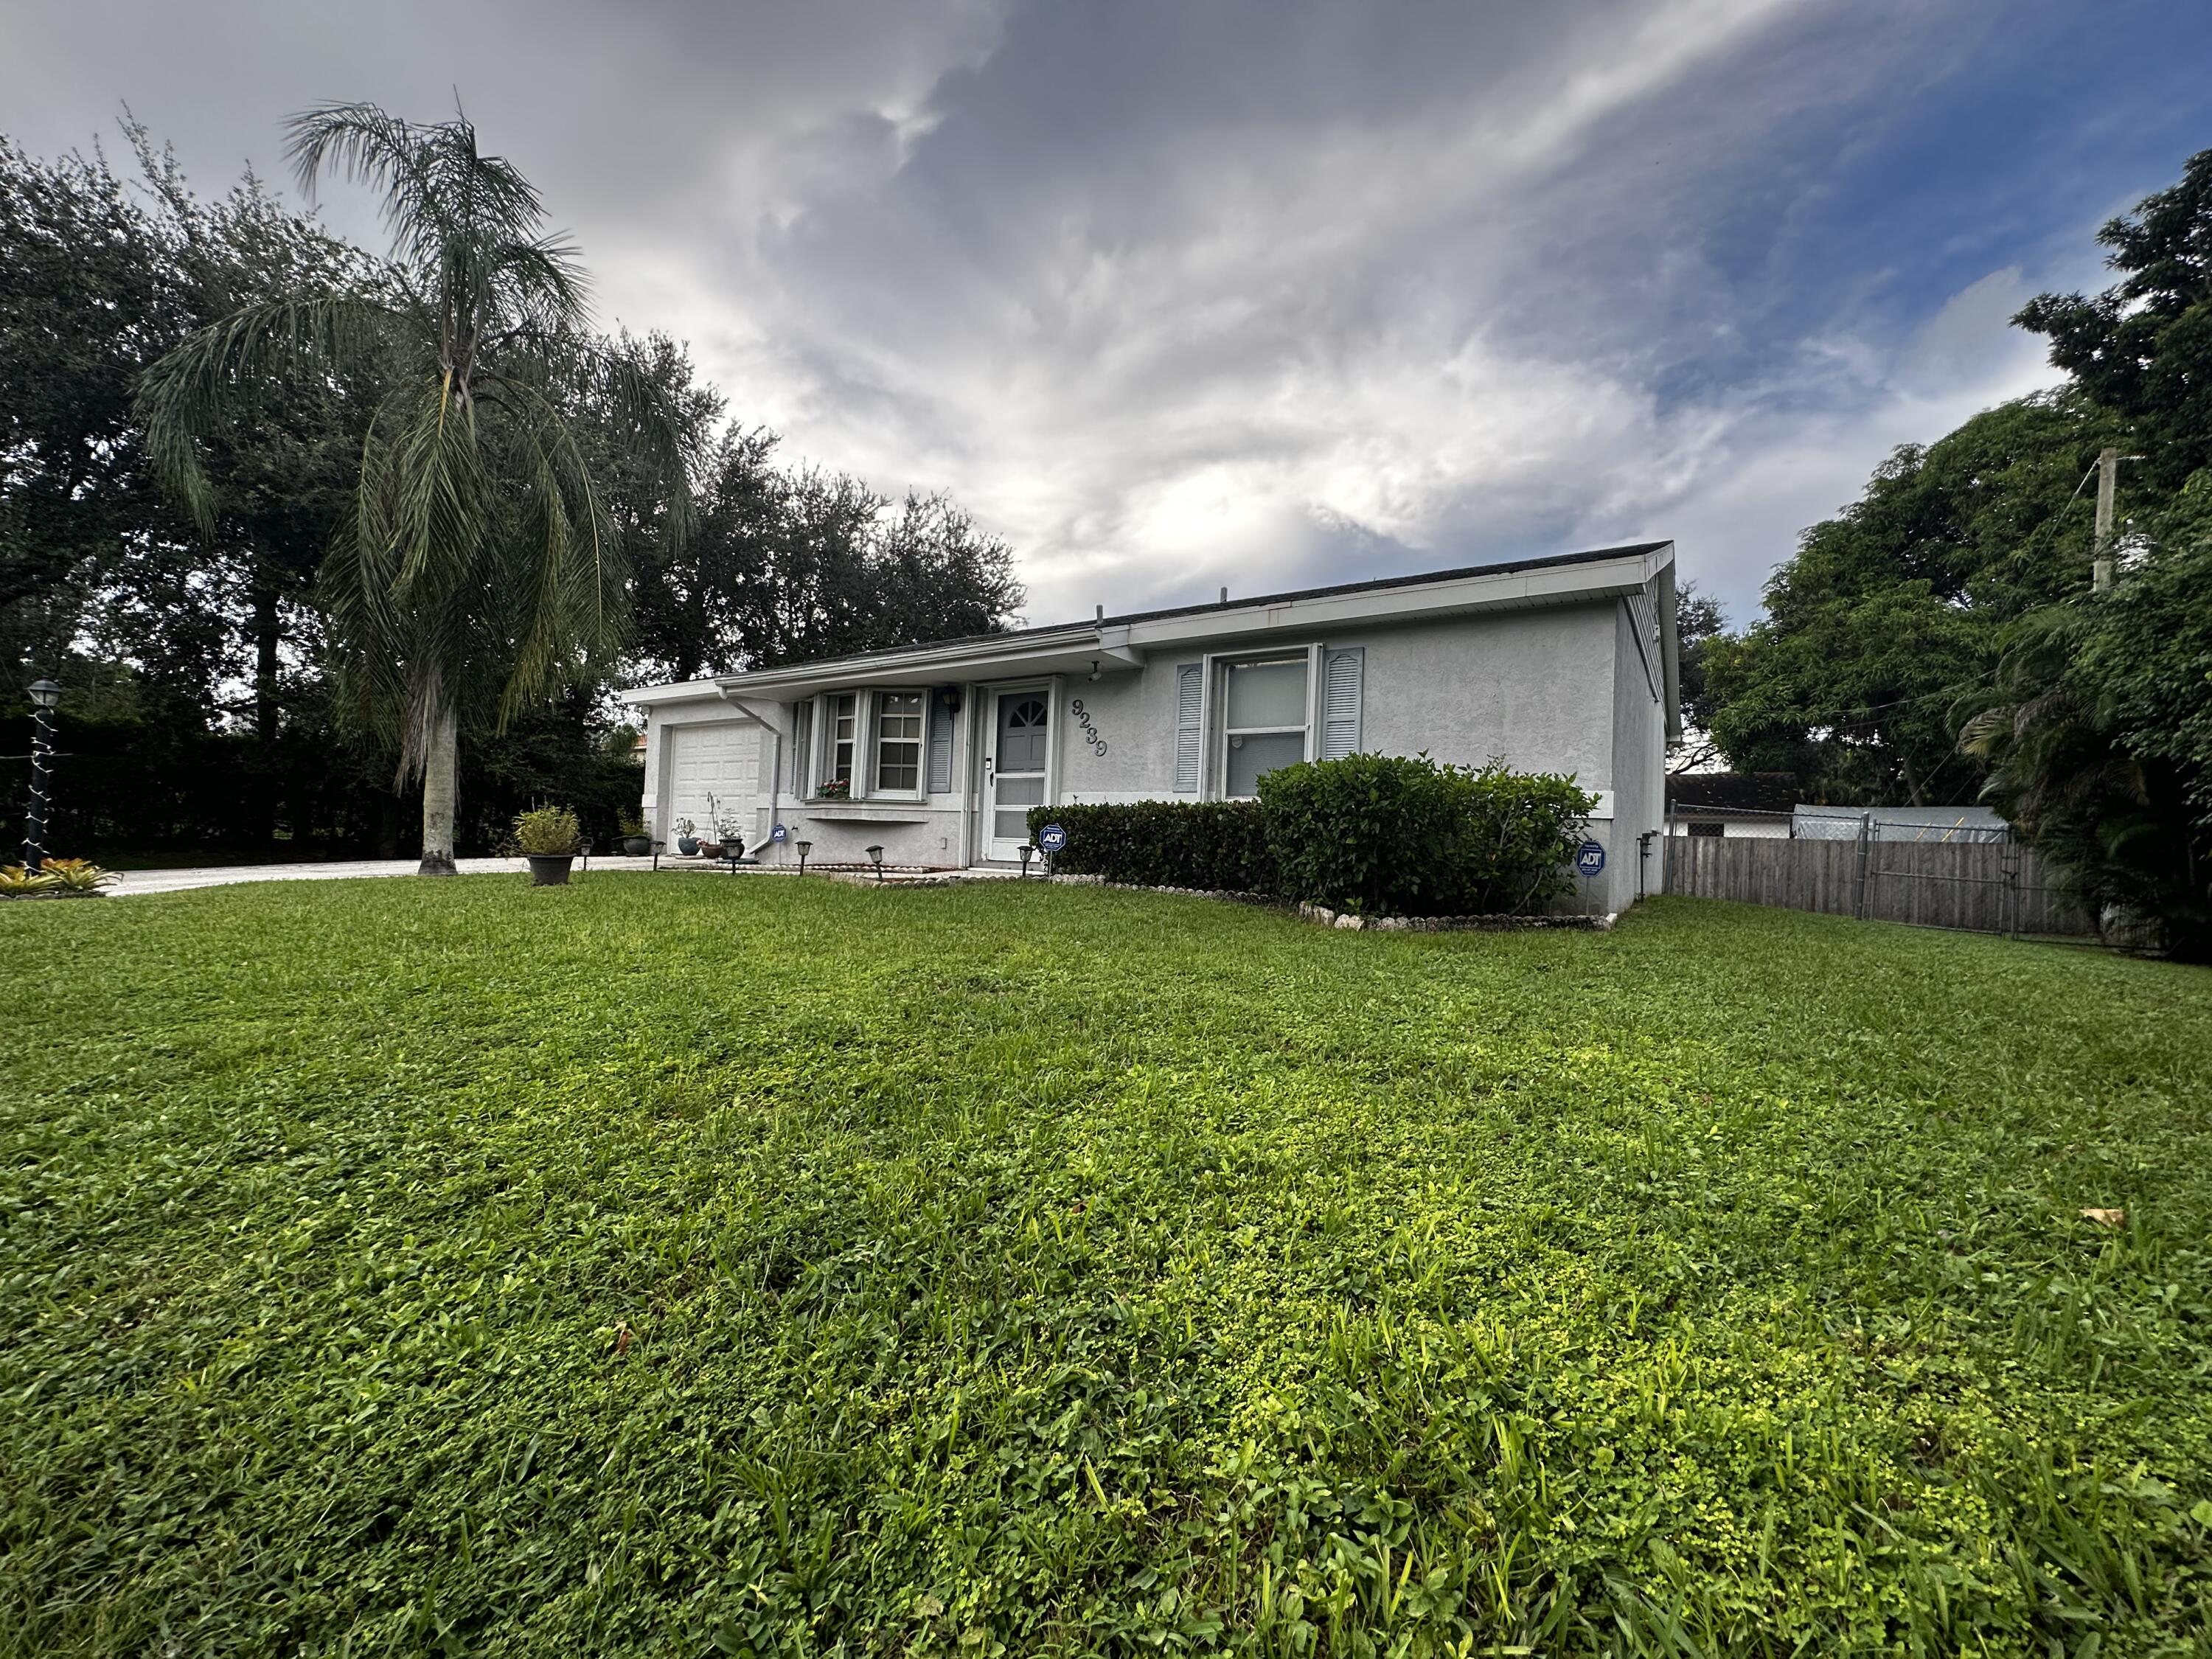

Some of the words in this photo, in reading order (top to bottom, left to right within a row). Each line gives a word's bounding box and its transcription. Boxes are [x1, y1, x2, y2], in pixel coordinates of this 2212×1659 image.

[1072, 699, 1107, 757] 9239
[1044, 833, 1062, 843] ADT
[1581, 852, 1601, 865] ADT
